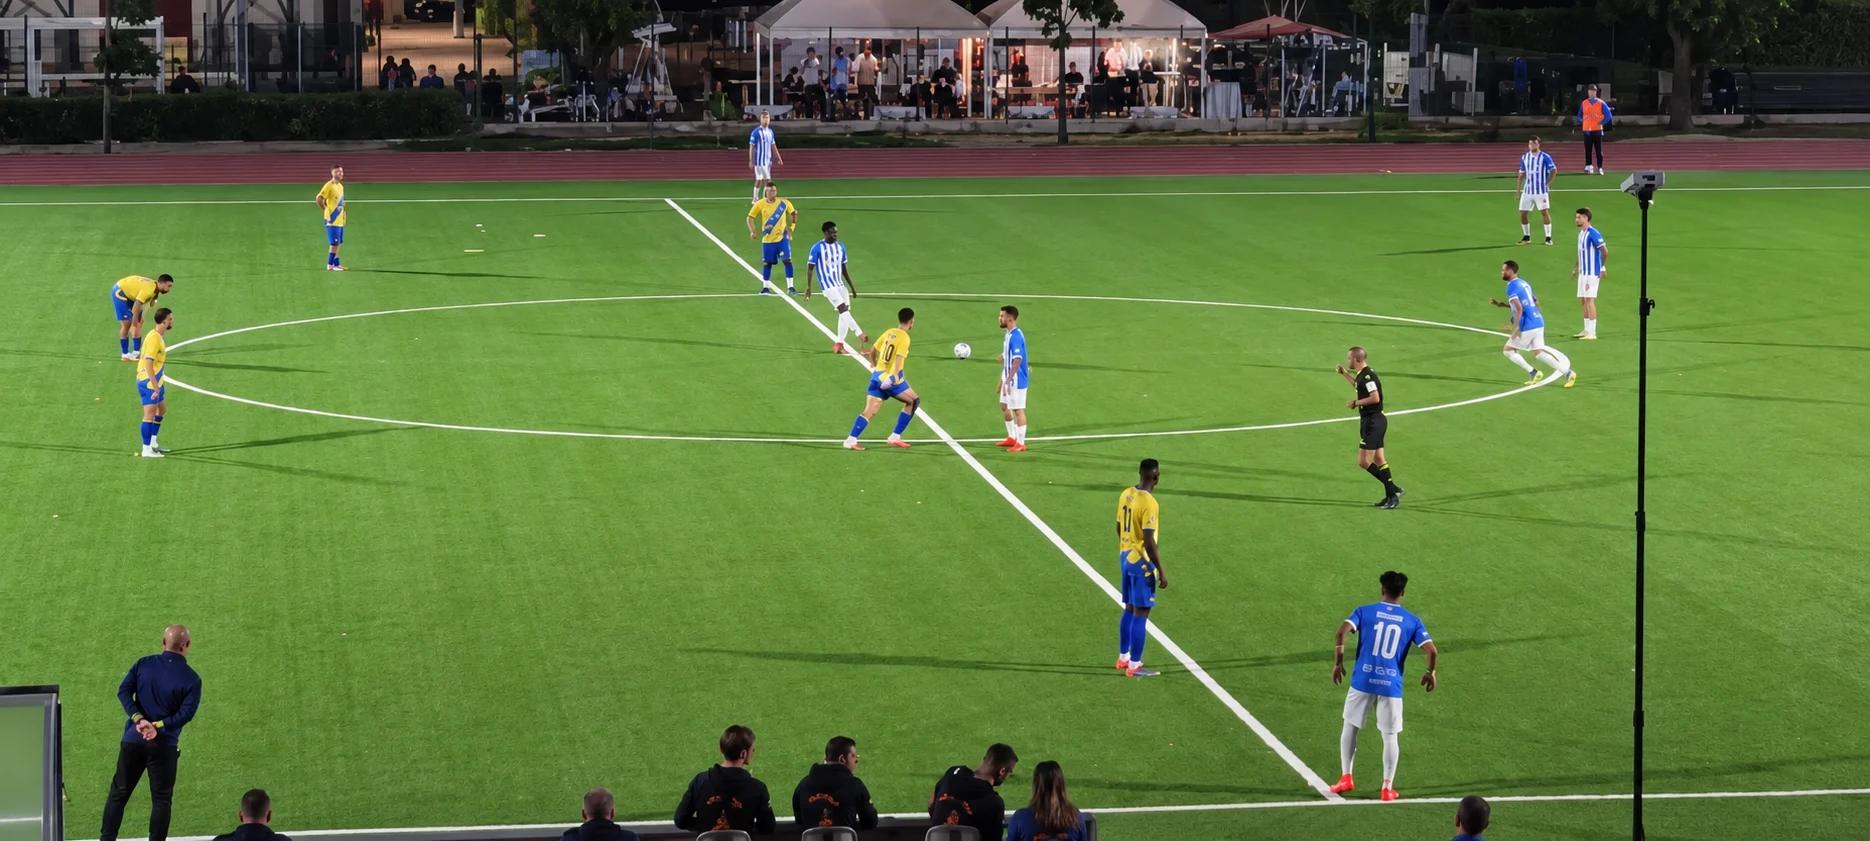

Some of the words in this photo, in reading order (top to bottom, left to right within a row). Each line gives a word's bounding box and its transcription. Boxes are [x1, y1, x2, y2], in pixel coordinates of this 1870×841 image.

[882, 340, 895, 362] 10
[1122, 505, 1132, 532] 11
[1372, 621, 1402, 659] 10
